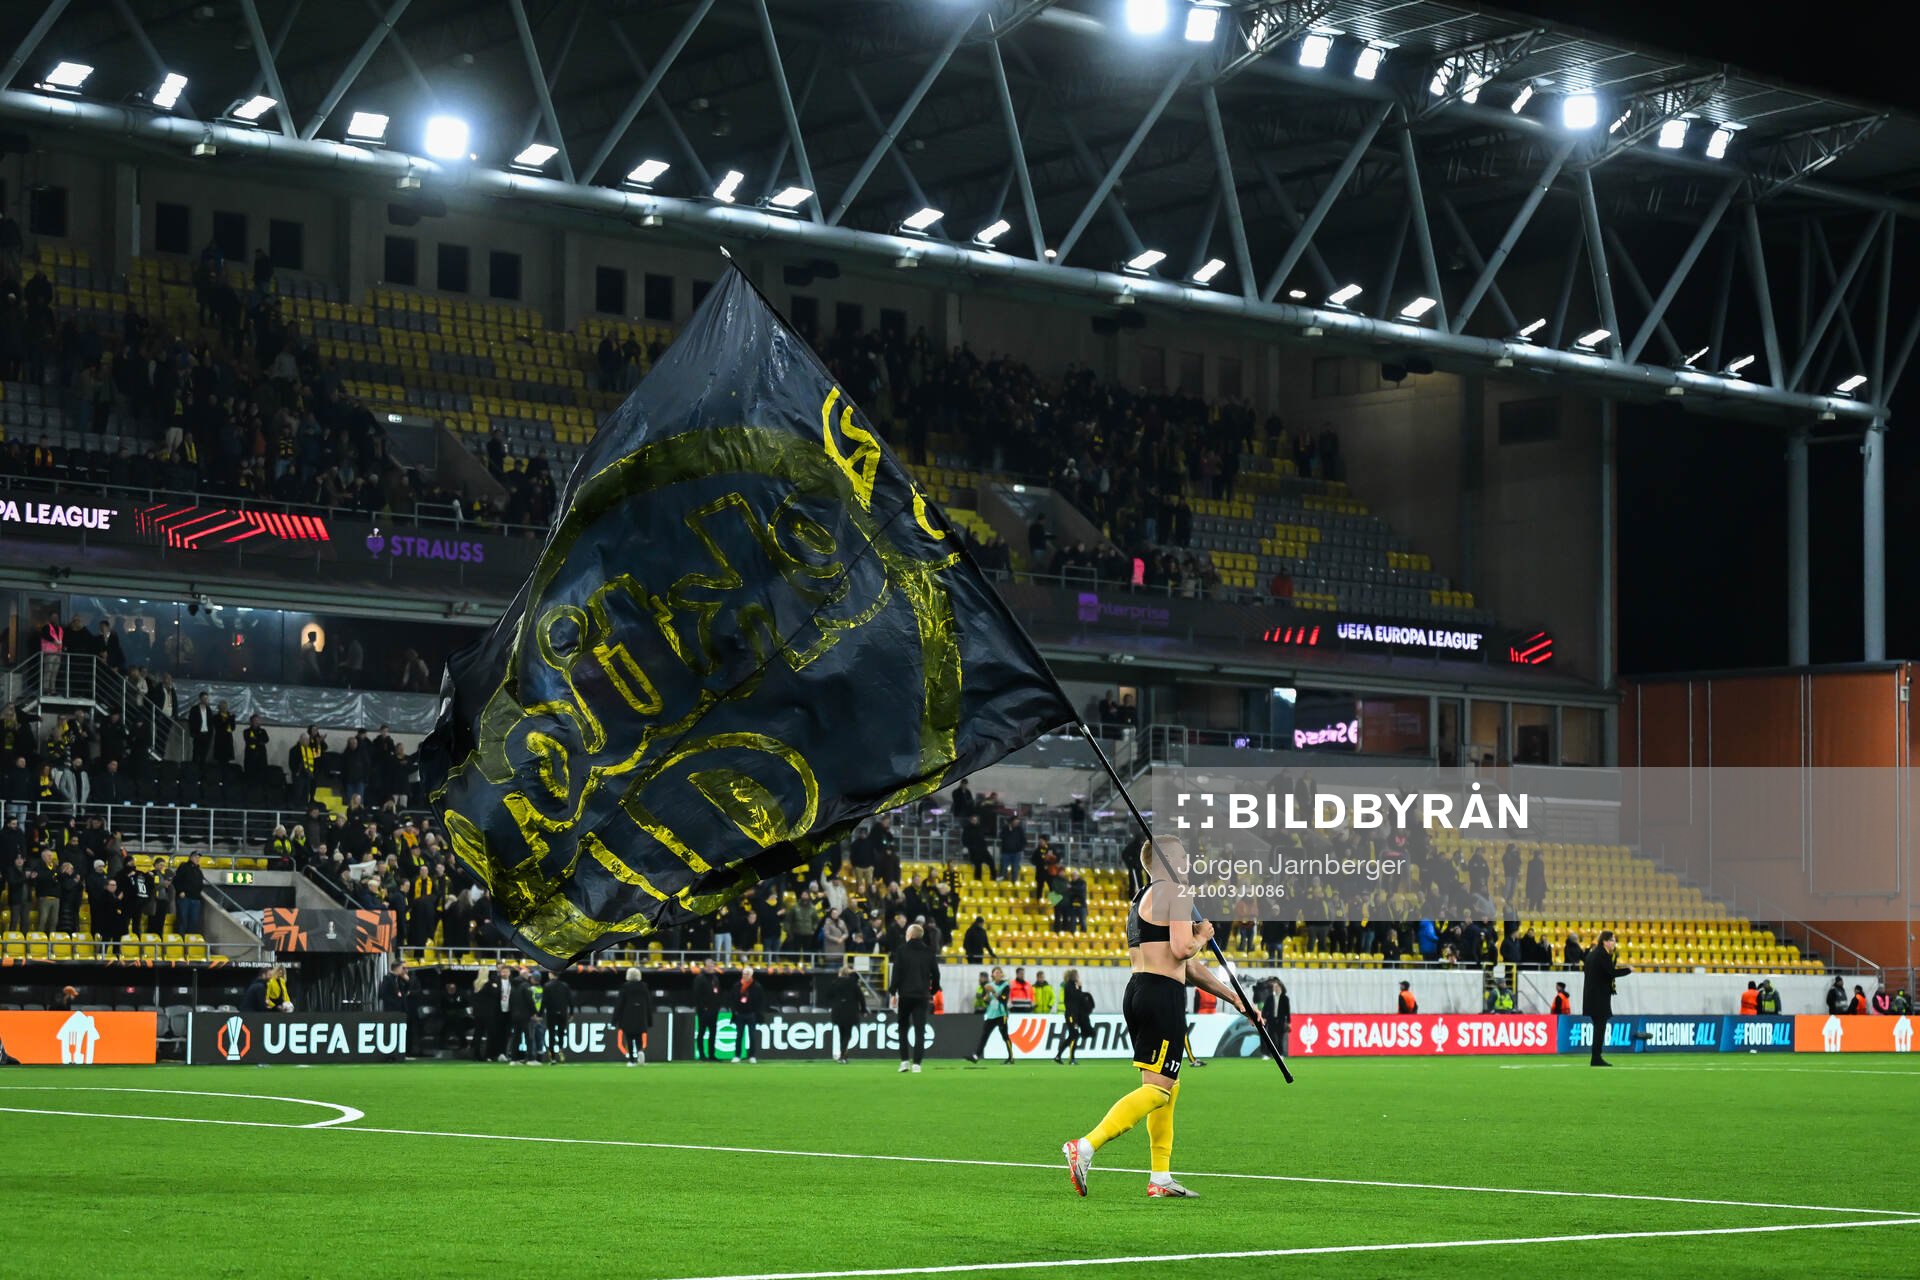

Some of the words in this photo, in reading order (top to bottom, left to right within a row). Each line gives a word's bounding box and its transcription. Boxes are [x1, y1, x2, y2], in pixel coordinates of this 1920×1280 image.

[391, 535, 485, 563] STRAUSS
[1337, 622, 1373, 641] UEFA
[1375, 625, 1427, 646] EUROPA
[264, 1023, 349, 1054] UEFA
[1327, 1022, 1423, 1048] STRAUSS
[1457, 1022, 1548, 1047] STRAUSS
[1569, 1023, 1631, 1046] #FOBALL
[1646, 1023, 1695, 1046] WELCOME
[1695, 1023, 1716, 1045] ALL
[1733, 1023, 1791, 1045] #FOOTBALL
[1170, 1060, 1181, 1073] 17
